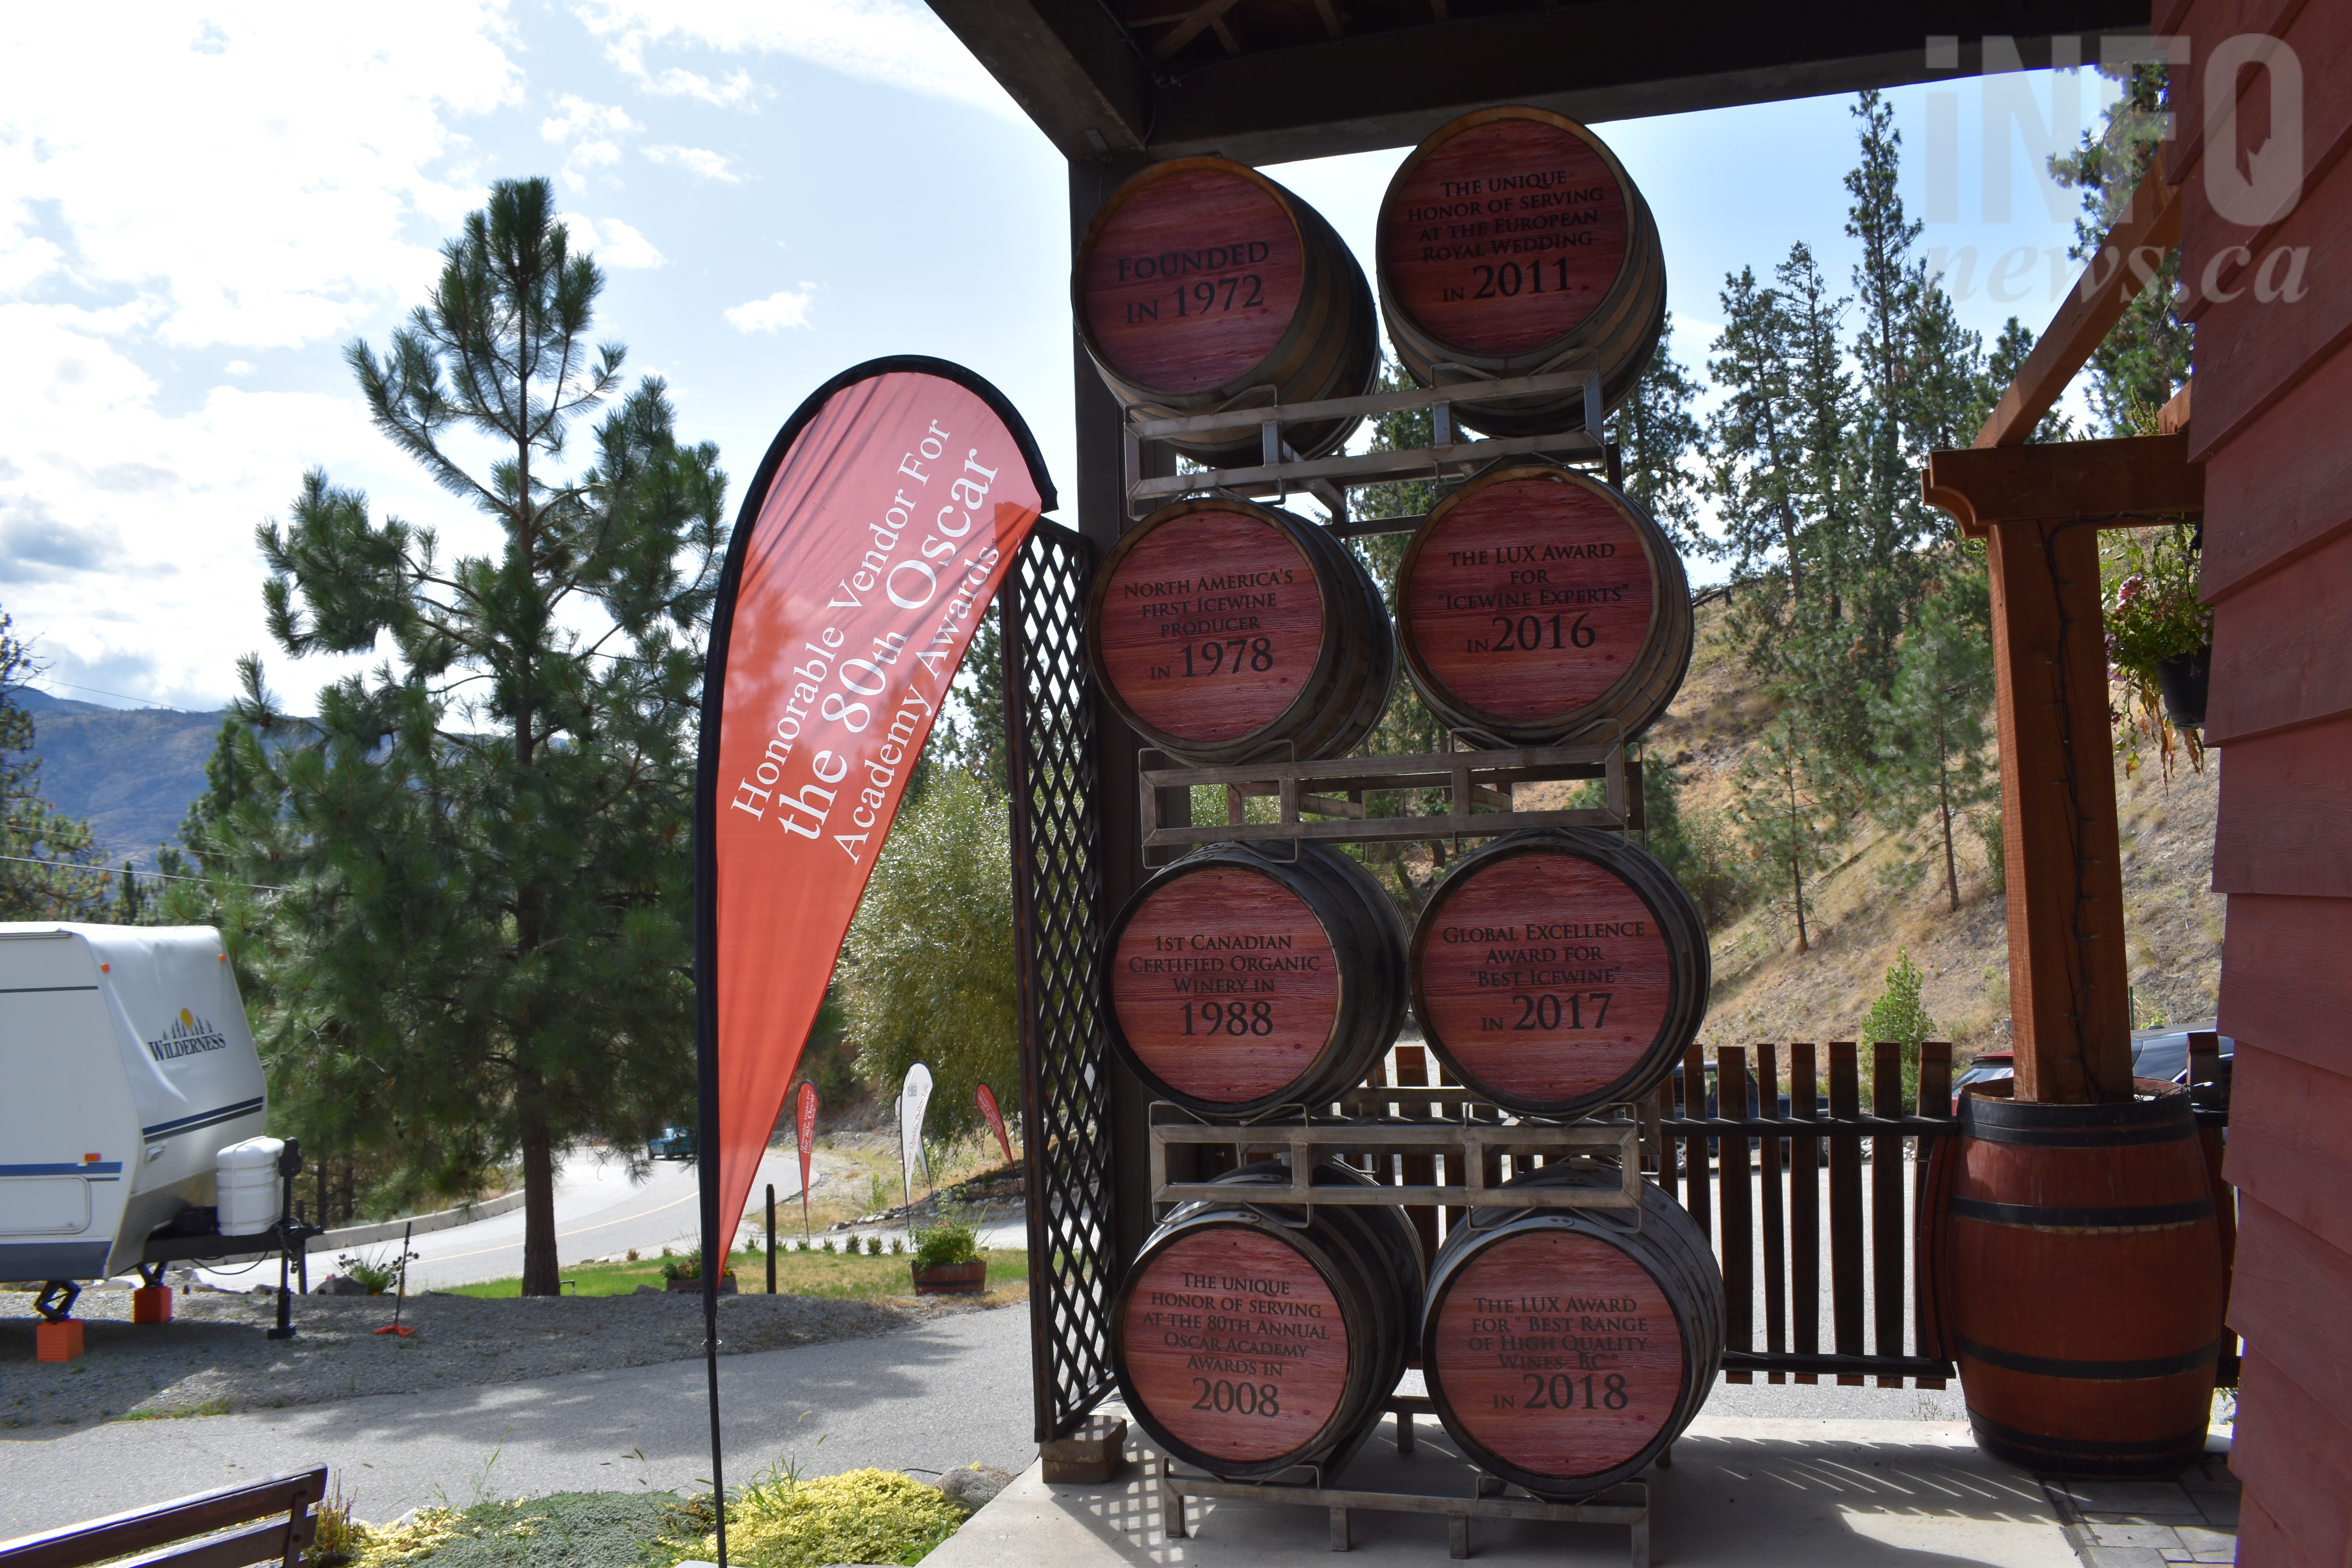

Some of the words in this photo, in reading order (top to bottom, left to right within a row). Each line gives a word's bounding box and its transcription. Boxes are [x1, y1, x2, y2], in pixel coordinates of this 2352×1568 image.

[1441, 180, 1482, 198] THE
[1488, 171, 1566, 192] UNIQUE
[1408, 201, 1483, 222] HONOR
[1488, 198, 1513, 212] OF
[1520, 187, 1604, 210] SERVING
[1419, 227, 1442, 242] AT
[1448, 221, 1487, 238] THE
[1495, 210, 1599, 234] EUROPEAN
[1423, 243, 1485, 263] ROYAL
[1491, 232, 1593, 255] WEDDING
[1117, 241, 1270, 282] FOUNDED
[1443, 287, 1464, 302] IN
[1472, 256, 1572, 299] 2011
[1126, 299, 1159, 324] IN
[1173, 274, 1264, 318] 1972
[1448, 551, 1488, 566] THE
[1495, 545, 1536, 563] LUX
[1542, 543, 1615, 561] AWARD
[1124, 579, 1191, 599] NORTH
[1197, 569, 1294, 591] AMERICA'S
[1510, 569, 1550, 584] FOR
[1142, 601, 1191, 618] FIRST
[1197, 592, 1276, 613] ICEWINE
[730, 626, 844, 822] Honorable
[827, 488, 917, 608] Vendor
[897, 419, 951, 486] For
[1160, 616, 1261, 637] PRODUCER
[1466, 638, 1489, 653] IN
[1491, 612, 1596, 652] 2016
[778, 749, 848, 839] the
[820, 630, 908, 734] 80th
[886, 449, 999, 610] Oscar
[1151, 665, 1171, 680] IN
[1180, 637, 1274, 678] 1978
[833, 684, 931, 865] Academy
[915, 544, 1000, 681] Awards
[1155, 936, 1185, 951] 1ST
[1191, 935, 1292, 950] CANADIAN
[1443, 927, 1518, 943] GLOBAL
[1525, 922, 1645, 940] EXCELLENCE
[1129, 956, 1224, 973] CERTIFIED
[1230, 955, 1320, 971] ORGANIC
[1485, 947, 1557, 964] AWARD
[1564, 946, 1604, 962] FOR
[1172, 978, 1247, 994] WINERY
[1254, 979, 1275, 992] IN
[1179, 1001, 1273, 1036] 1988
[1482, 1016, 1503, 1031] IN
[1512, 993, 1613, 1031] 2017
[148, 1033, 226, 1061] WILDERNESS
[1181, 1272, 1216, 1289] THE
[1222, 1277, 1289, 1296] UNIQUE
[1152, 1293, 1215, 1309] HONOR
[1221, 1298, 1242, 1312] OF
[1249, 1300, 1321, 1318] SERVING
[1473, 1298, 1514, 1313] THE
[1520, 1297, 1561, 1312] LUX
[1565, 1297, 1637, 1312] AWARD
[1143, 1312, 1163, 1325] AT
[1168, 1314, 1201, 1328] THE
[1207, 1315, 1250, 1332] 80TH
[1257, 1320, 1329, 1339] ANNUAL
[1472, 1318, 1511, 1332] FOR
[1581, 1316, 1647, 1332] RANGE
[1164, 1332, 1220, 1350] OSCAR
[1226, 1338, 1308, 1358] ACADEMY
[1469, 1337, 1493, 1351] OF
[1501, 1335, 1554, 1351] HIGH
[1562, 1335, 1648, 1354] QUALITY
[1187, 1355, 1257, 1375] AWARDS
[1264, 1362, 1283, 1377] IN
[1192, 1377, 1280, 1417] 2008
[1493, 1395, 1515, 1409] IN
[1523, 1374, 1628, 1410] 2018
